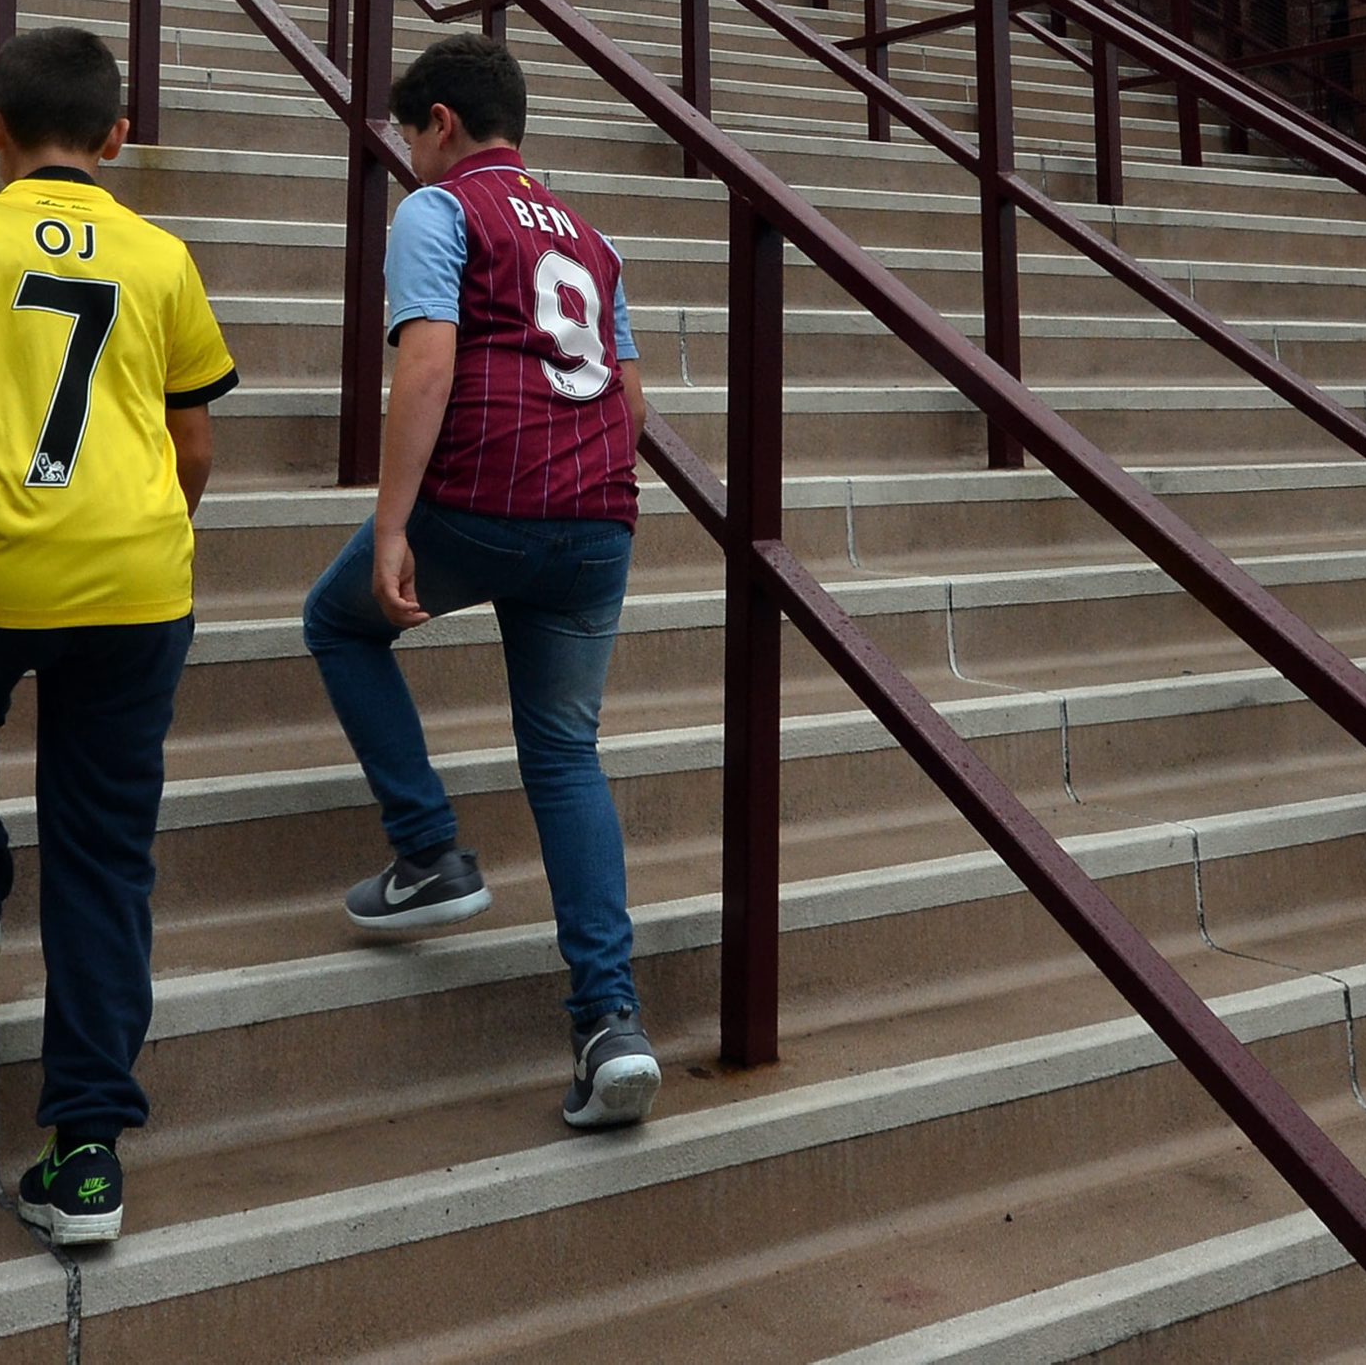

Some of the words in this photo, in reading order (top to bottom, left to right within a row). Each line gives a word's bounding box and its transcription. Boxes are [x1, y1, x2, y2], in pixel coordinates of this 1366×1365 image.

[508, 196, 579, 239] BEN
[34, 219, 96, 261] OJ
[534, 249, 611, 401] 9
[11, 270, 120, 488] 7
[83, 1177, 106, 1189] NIKE
[83, 1195, 105, 1204] AIR
